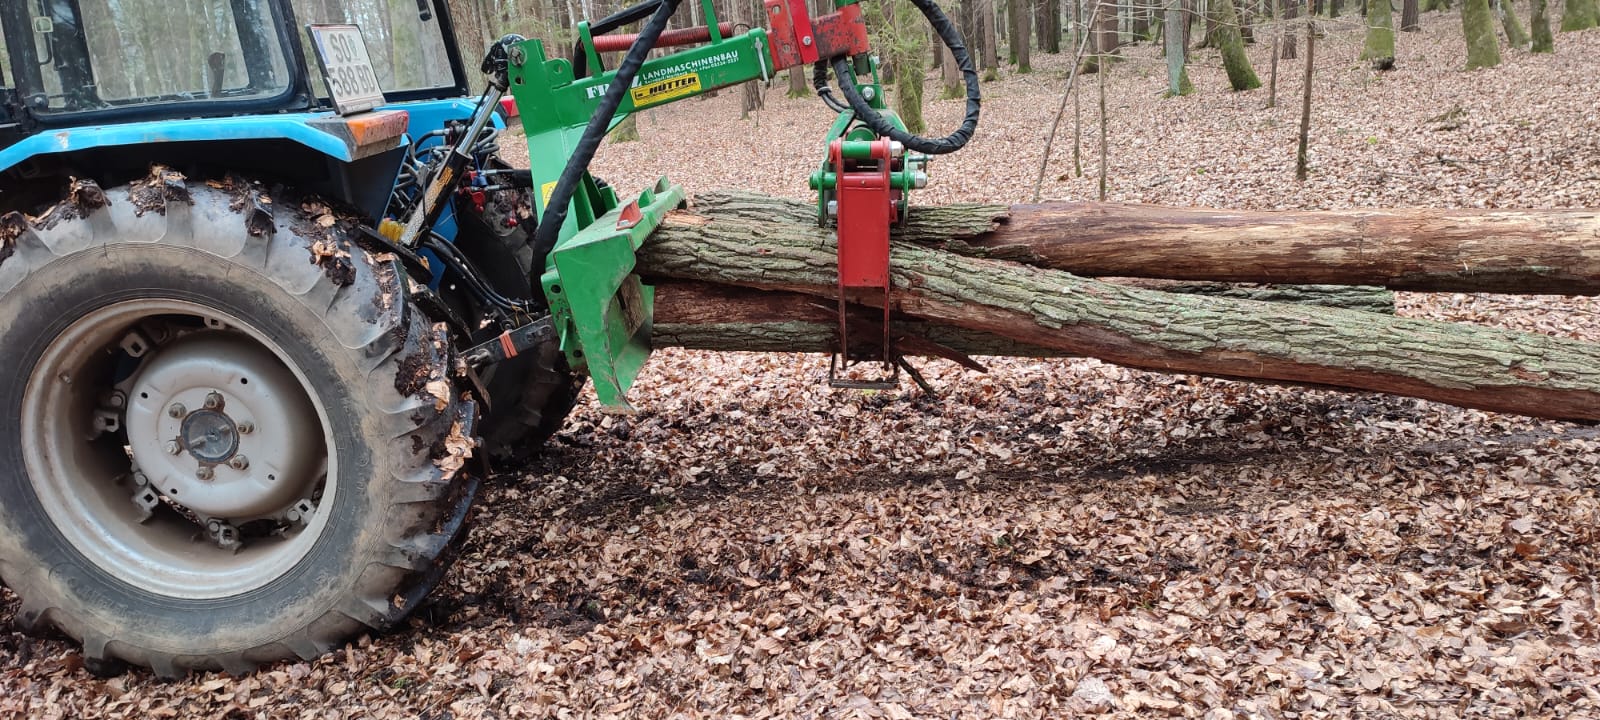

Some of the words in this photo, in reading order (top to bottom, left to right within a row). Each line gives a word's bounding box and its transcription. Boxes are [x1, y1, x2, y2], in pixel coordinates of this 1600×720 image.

[329, 33, 352, 63] SO
[642, 50, 739, 80] LANDMASCHINENBAU
[327, 66, 360, 97] 588
[355, 64, 376, 93] BD
